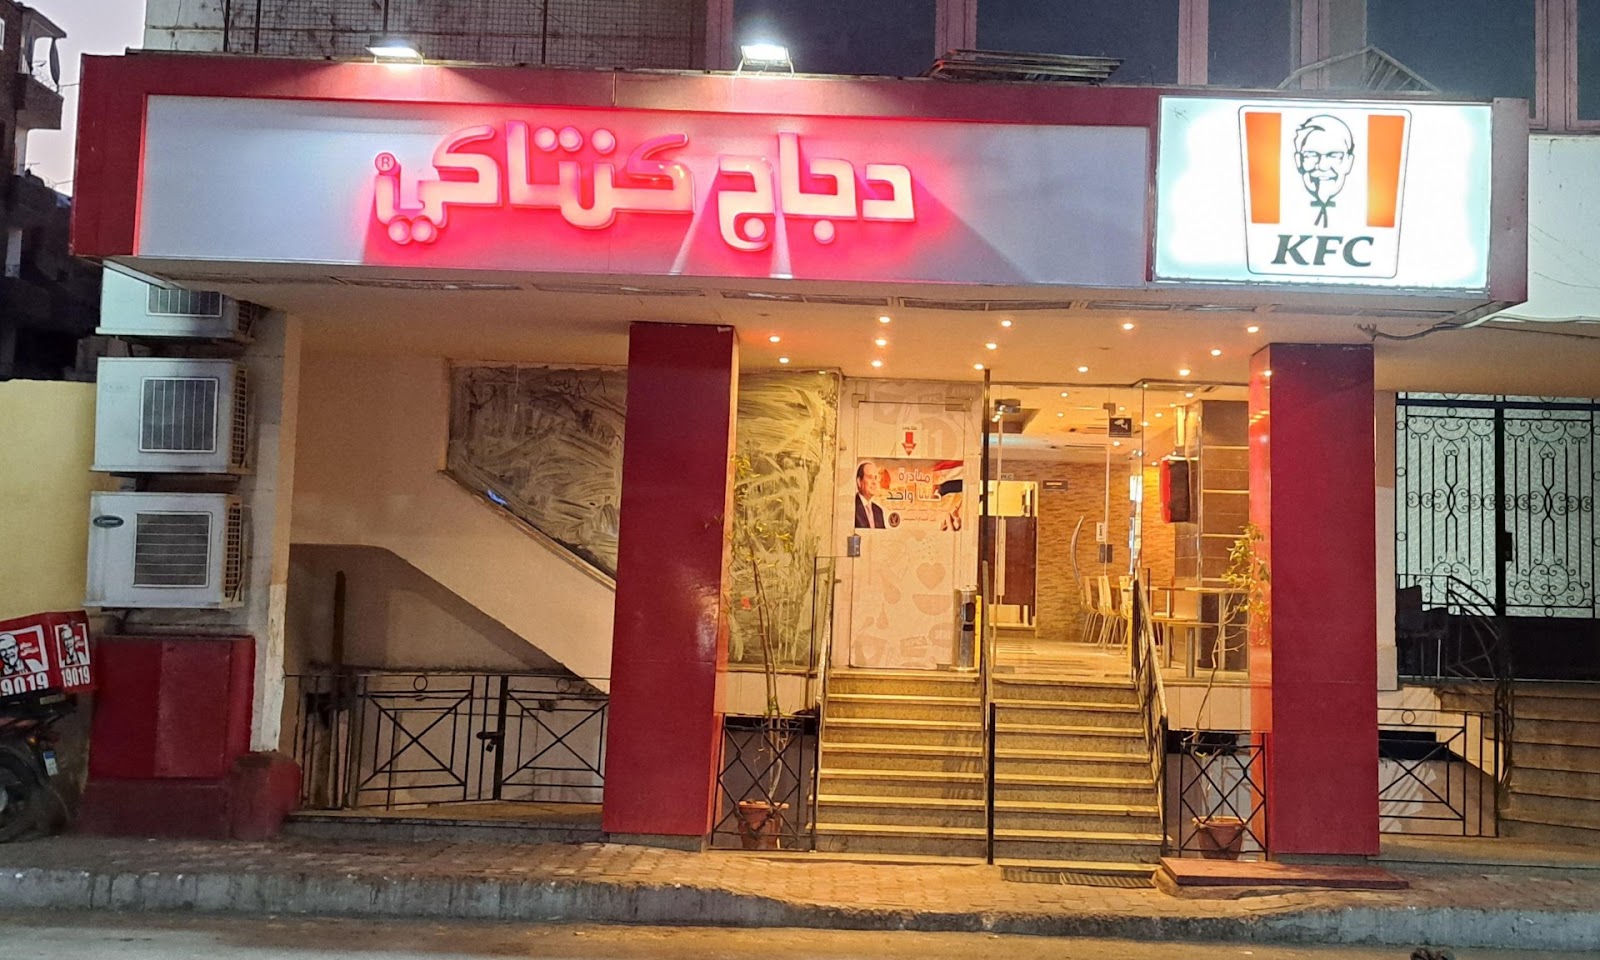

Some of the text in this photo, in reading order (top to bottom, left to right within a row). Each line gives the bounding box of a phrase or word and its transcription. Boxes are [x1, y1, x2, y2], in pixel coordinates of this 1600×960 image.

[374, 119, 916, 252] دجاج كنتاكي
[1271, 234, 1374, 267] KFC
[886, 488, 914, 504] واحد
[0, 672, 49, 697] 9019
[61, 666, 90, 688] 19019
